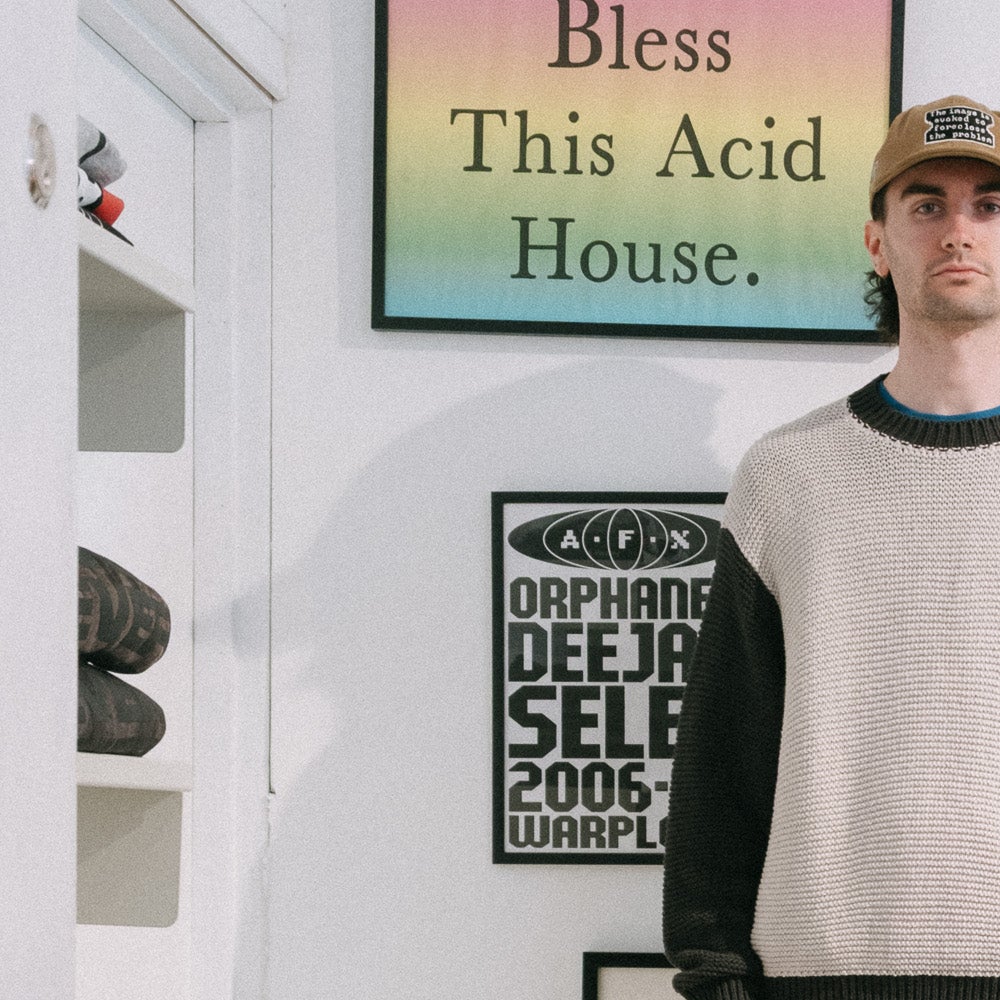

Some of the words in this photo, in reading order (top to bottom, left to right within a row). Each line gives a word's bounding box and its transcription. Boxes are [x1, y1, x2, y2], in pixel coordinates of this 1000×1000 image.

[547, 0, 733, 73] Bless
[450, 107, 616, 177] This
[655, 115, 827, 182] Acid
[509, 215, 761, 287] House.
[507, 621, 699, 684] DEEJA
[507, 685, 688, 760] SELE
